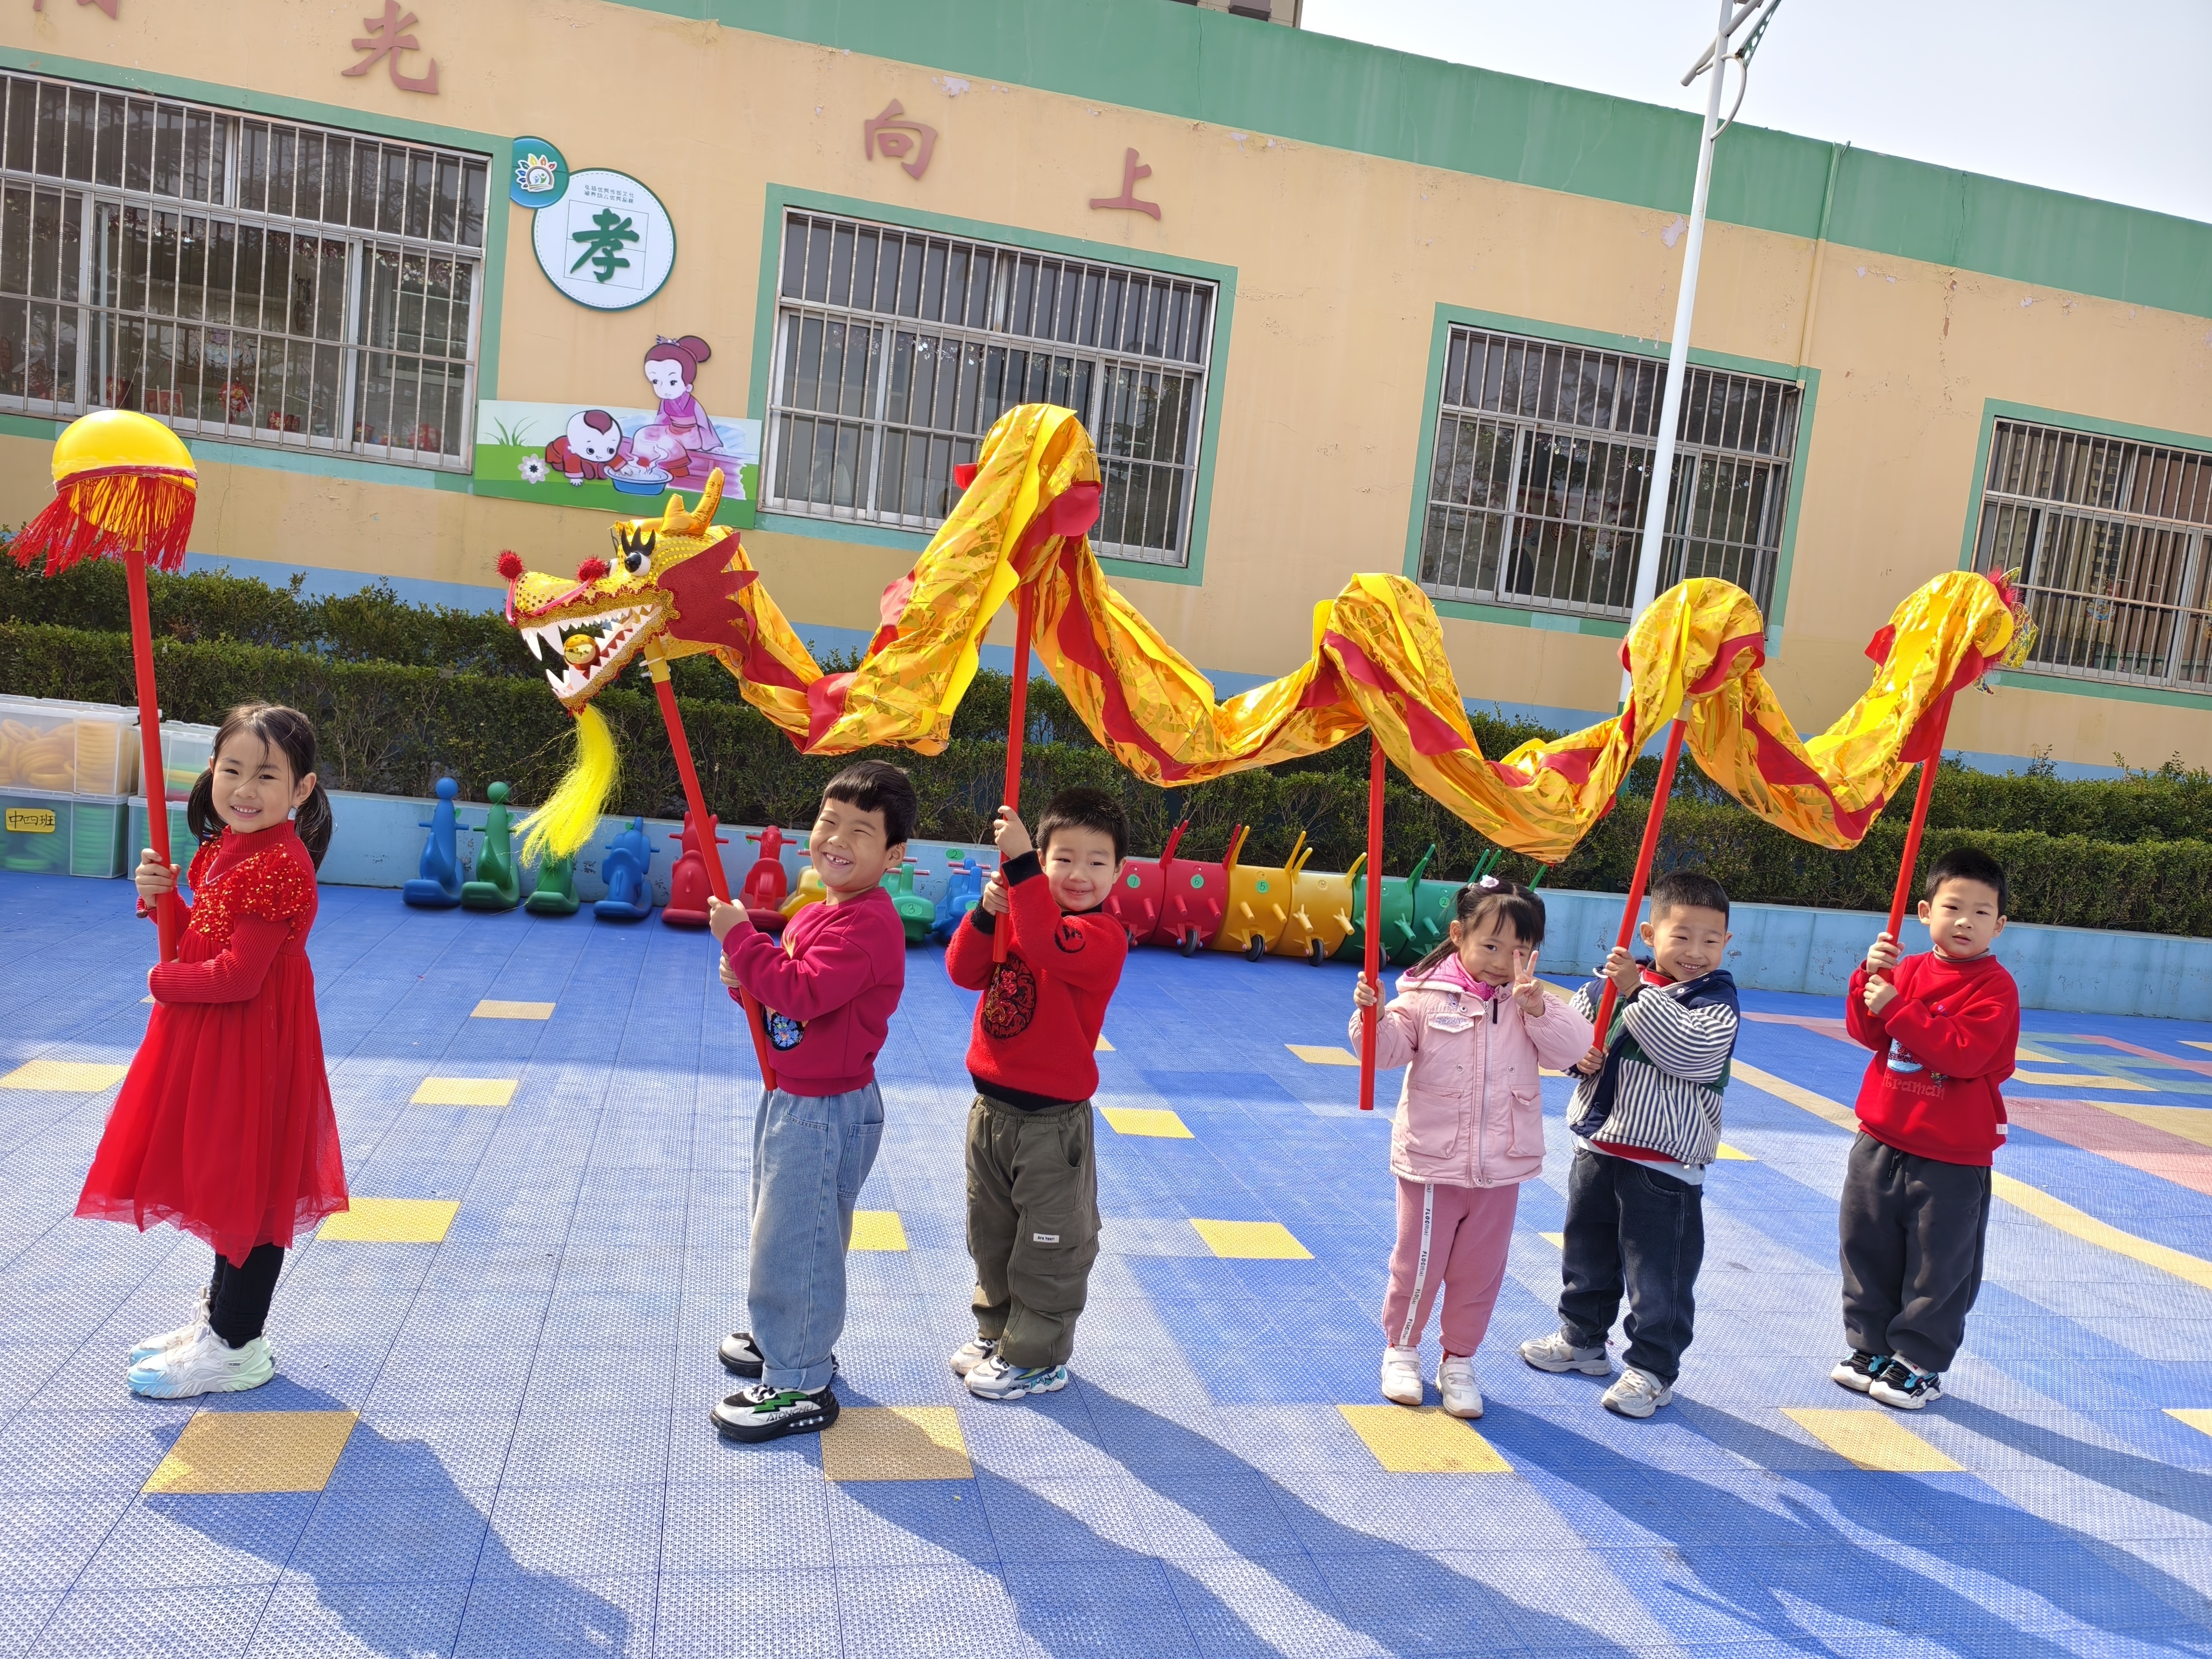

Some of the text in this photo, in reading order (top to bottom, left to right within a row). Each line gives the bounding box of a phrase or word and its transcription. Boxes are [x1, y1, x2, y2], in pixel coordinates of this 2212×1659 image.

[341, 0, 1162, 221] 光 向 上
[570, 208, 640, 282] 孝
[8, 811, 55, 829] 中四班
[950, 850, 958, 859] 2
[1131, 876, 1137, 886] 7
[1195, 877, 1199, 886] 6
[1260, 881, 1265, 891] 5
[908, 904, 915, 914] 3
[766, 1403, 814, 1422] ATONGMU
